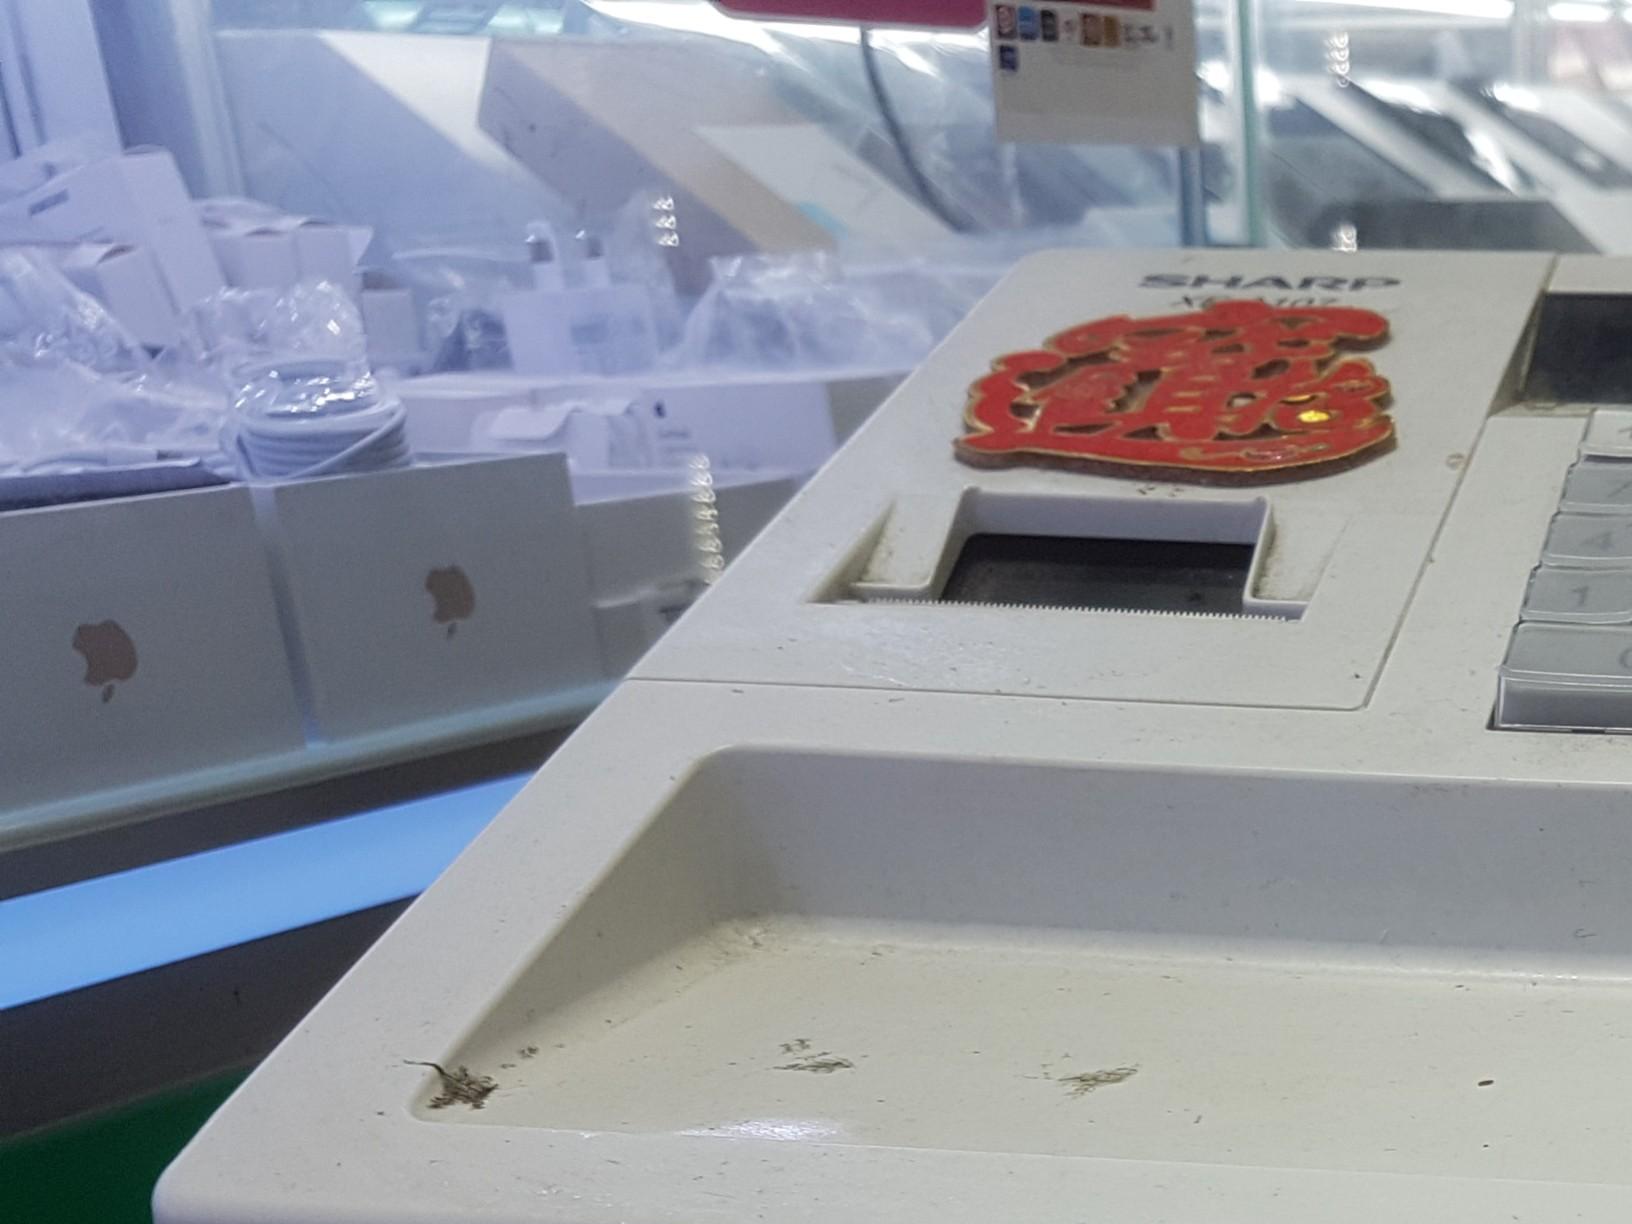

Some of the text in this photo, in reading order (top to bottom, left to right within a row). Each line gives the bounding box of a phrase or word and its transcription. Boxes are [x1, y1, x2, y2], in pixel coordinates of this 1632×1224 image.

[1140, 274, 1402, 291] SHARP
[1579, 530, 1614, 551] 4
[1570, 586, 1590, 607] 1
